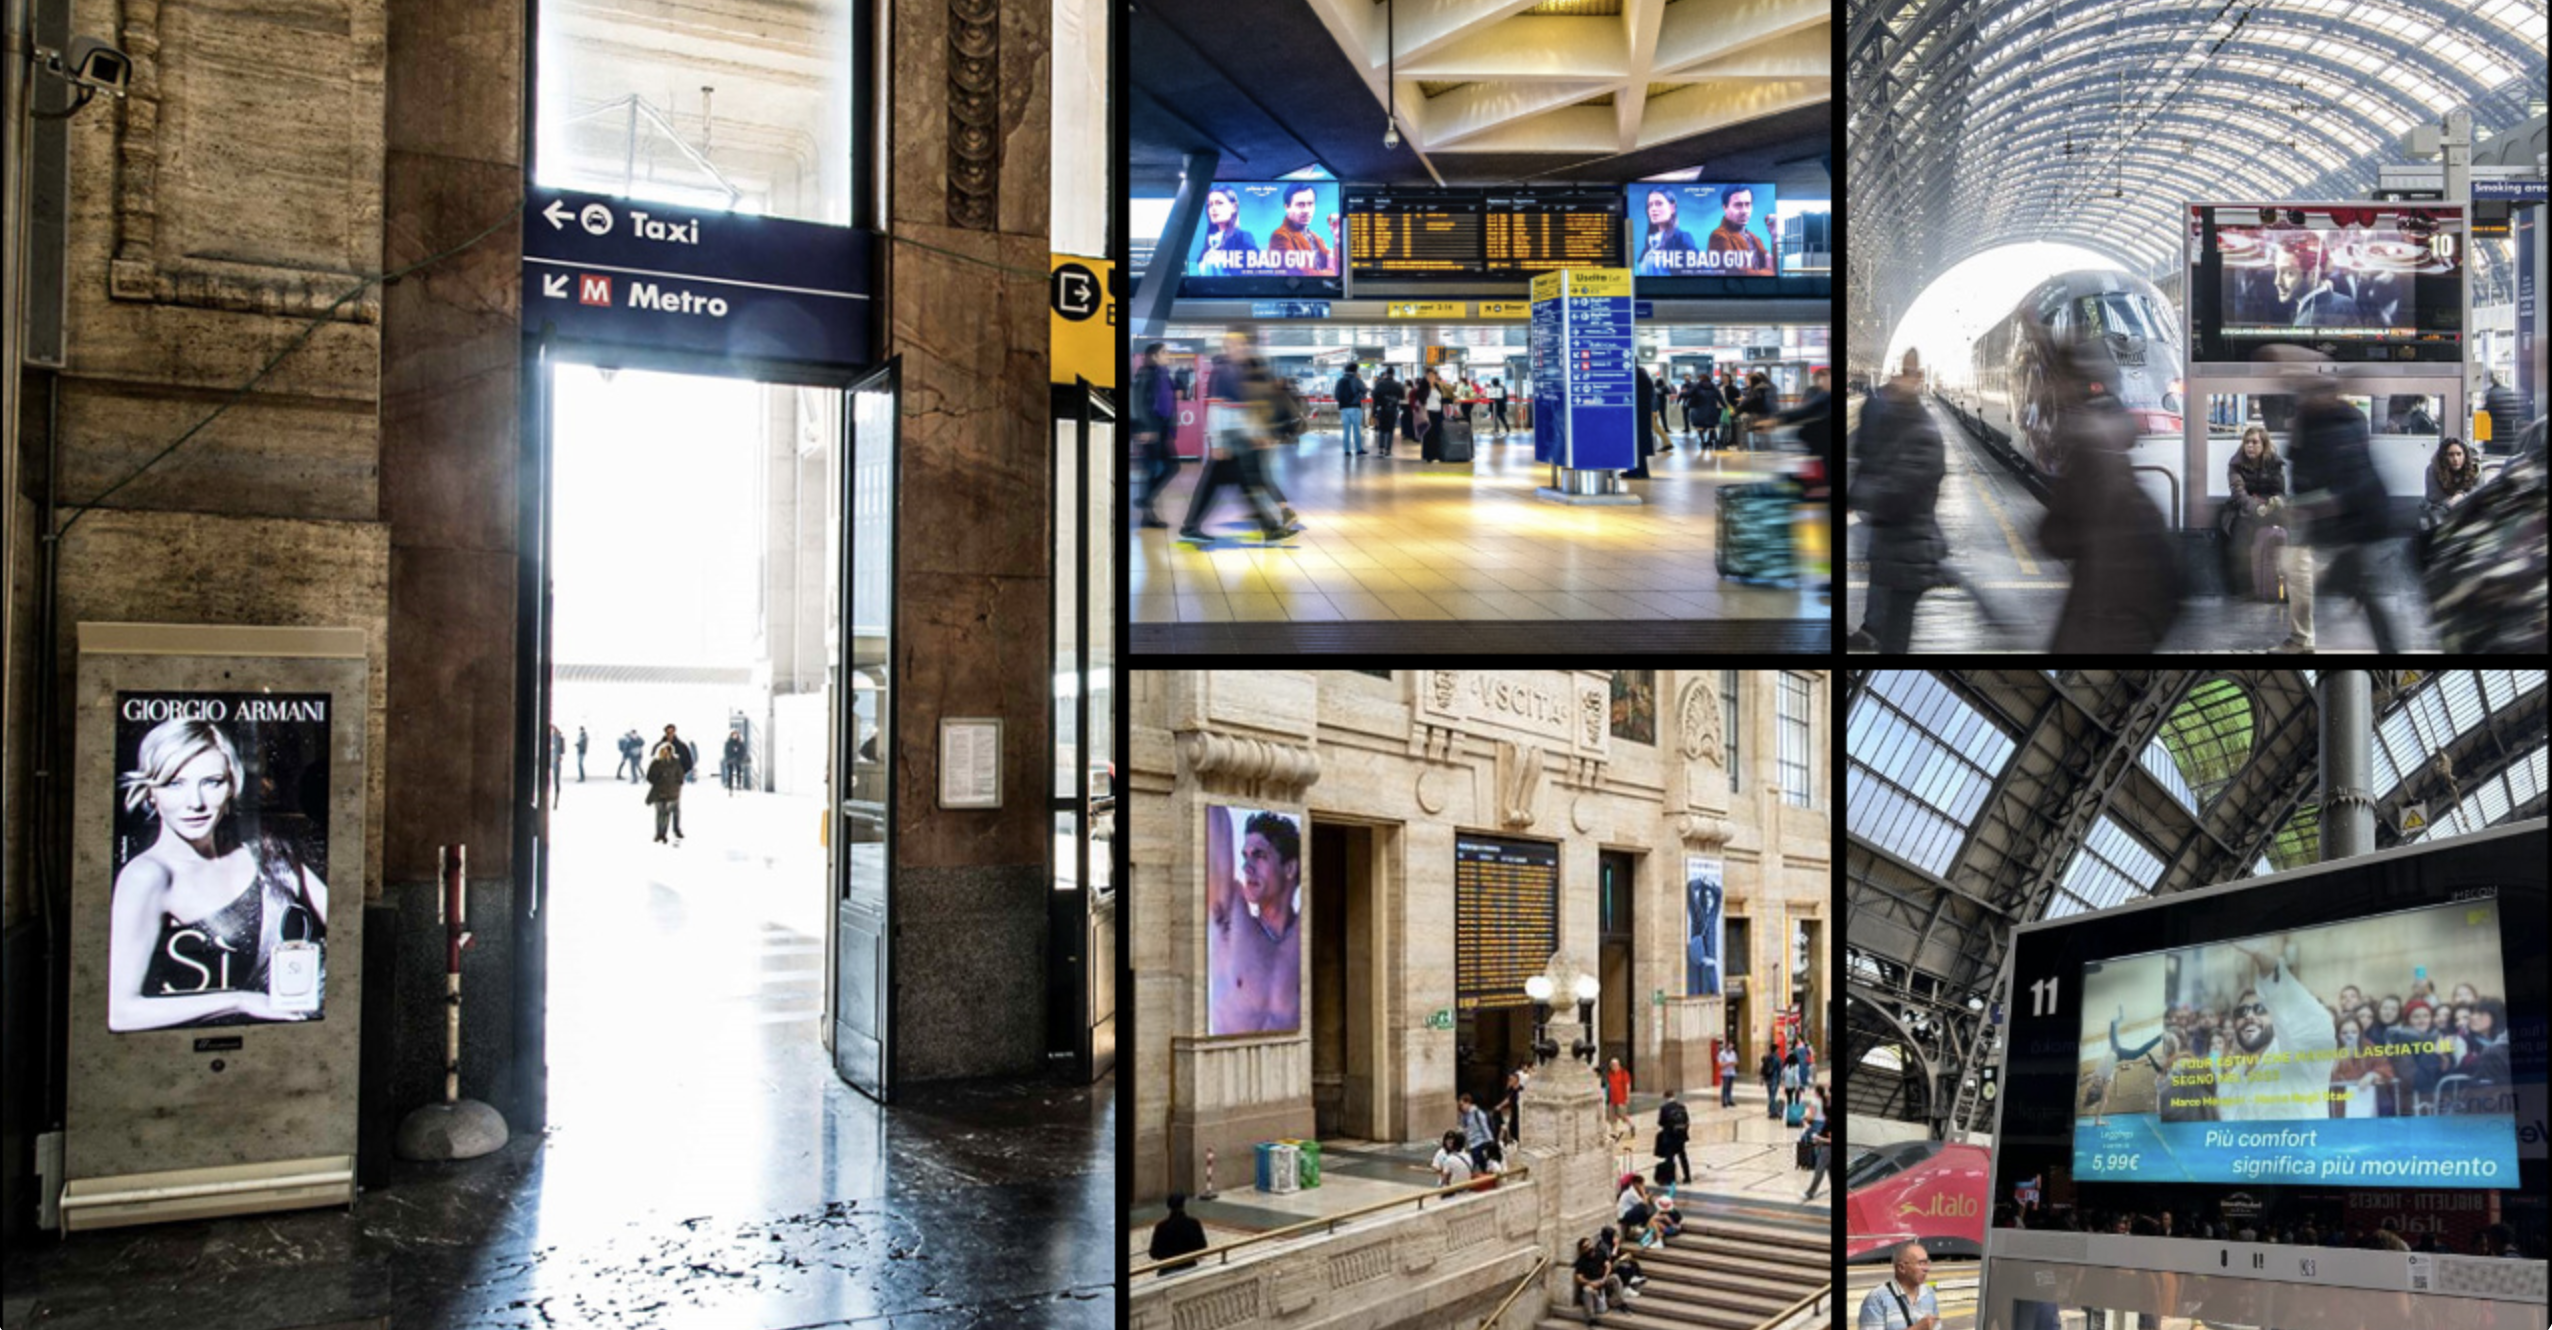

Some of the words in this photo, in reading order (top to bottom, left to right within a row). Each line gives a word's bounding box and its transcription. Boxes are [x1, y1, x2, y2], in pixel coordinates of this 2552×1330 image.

[2474, 182, 2522, 195] Smoking
[630, 211, 699, 245] Taxi
[2429, 234, 2455, 258] 10
[1212, 249, 1244, 268] THE
[1246, 249, 1280, 268] BAD
[1284, 249, 1317, 268] GUY
[1653, 249, 1684, 268] THE
[1686, 249, 1721, 268] BAD
[1722, 249, 1755, 268] GUY
[582, 279, 611, 304] M
[628, 281, 729, 318] Metro
[122, 698, 228, 722] GIORGIO
[234, 700, 325, 723] ARMANI
[2030, 976, 2059, 1017] 11
[2354, 1041, 2435, 1059] LASCIATO
[2172, 1073, 2214, 1087] SEGNO
[2170, 1096, 2201, 1108] Marco
[2204, 1128, 2234, 1147] Più
[2238, 1127, 2318, 1148] comfort
[2092, 1153, 2140, 1174] 5,99€
[2232, 1154, 2316, 1178] significa
[2320, 1154, 2356, 1179] più
[2361, 1154, 2498, 1177] movimento
[1927, 1191, 1978, 1217] italo
